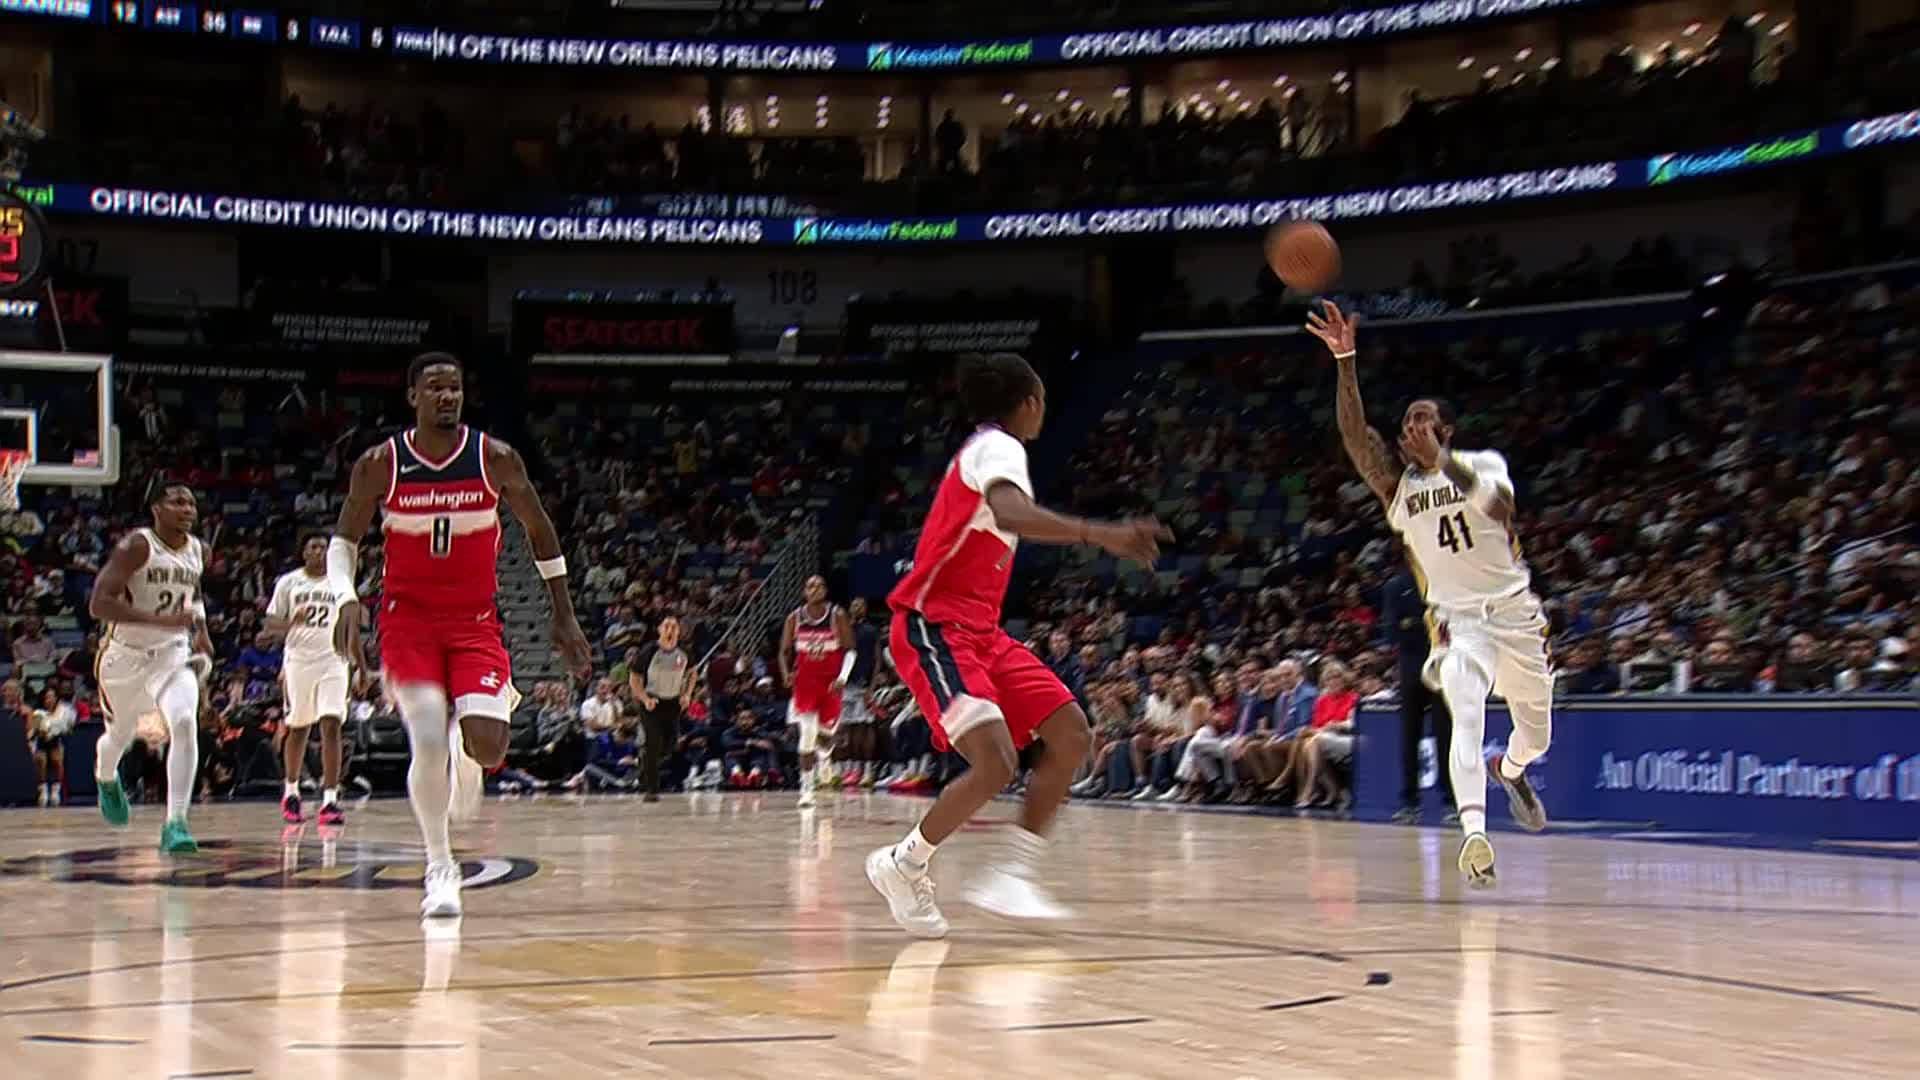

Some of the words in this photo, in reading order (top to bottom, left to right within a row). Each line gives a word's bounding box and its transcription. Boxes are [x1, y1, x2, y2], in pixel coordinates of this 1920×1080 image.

[460, 36, 498, 59] OF
[498, 37, 544, 61] THE
[548, 40, 606, 64] NEW
[609, 42, 719, 67] ORLEANS
[722, 45, 837, 70] PELICANS
[1060, 30, 1167, 59] OFFICIAL
[1167, 22, 1254, 52] CREDIT
[1254, 17, 1335, 46] UNION
[1335, 12, 1374, 38] OF
[1372, 5, 1420, 34] THE
[1416, 0, 1478, 27] NEW
[90, 188, 210, 219] OFFICIAL
[213, 197, 305, 225] CREDIT
[308, 203, 388, 231] UNION
[391, 209, 426, 233] OF
[427, 211, 475, 236] THE
[478, 215, 536, 239] NEW
[538, 217, 647, 241] ORLEANS
[650, 218, 763, 243] PELICANS
[984, 212, 1087, 239] OFFICIAL
[1087, 207, 1174, 234] CREDIT
[1173, 203, 1248, 230] UNION
[1250, 200, 1291, 226] OF
[1290, 196, 1333, 220] THE
[1334, 190, 1391, 216] NEW
[1391, 177, 1498, 212] ORLEANS
[1497, 162, 1617, 199] PELICANS
[399, 488, 483, 510] washington
[1438, 511, 1474, 555] 41
[304, 604, 329, 628] 22
[1595, 752, 1633, 790] An
[1635, 750, 1733, 793] Official
[1737, 754, 1854, 798] Partner
[1856, 754, 1898, 800] of
